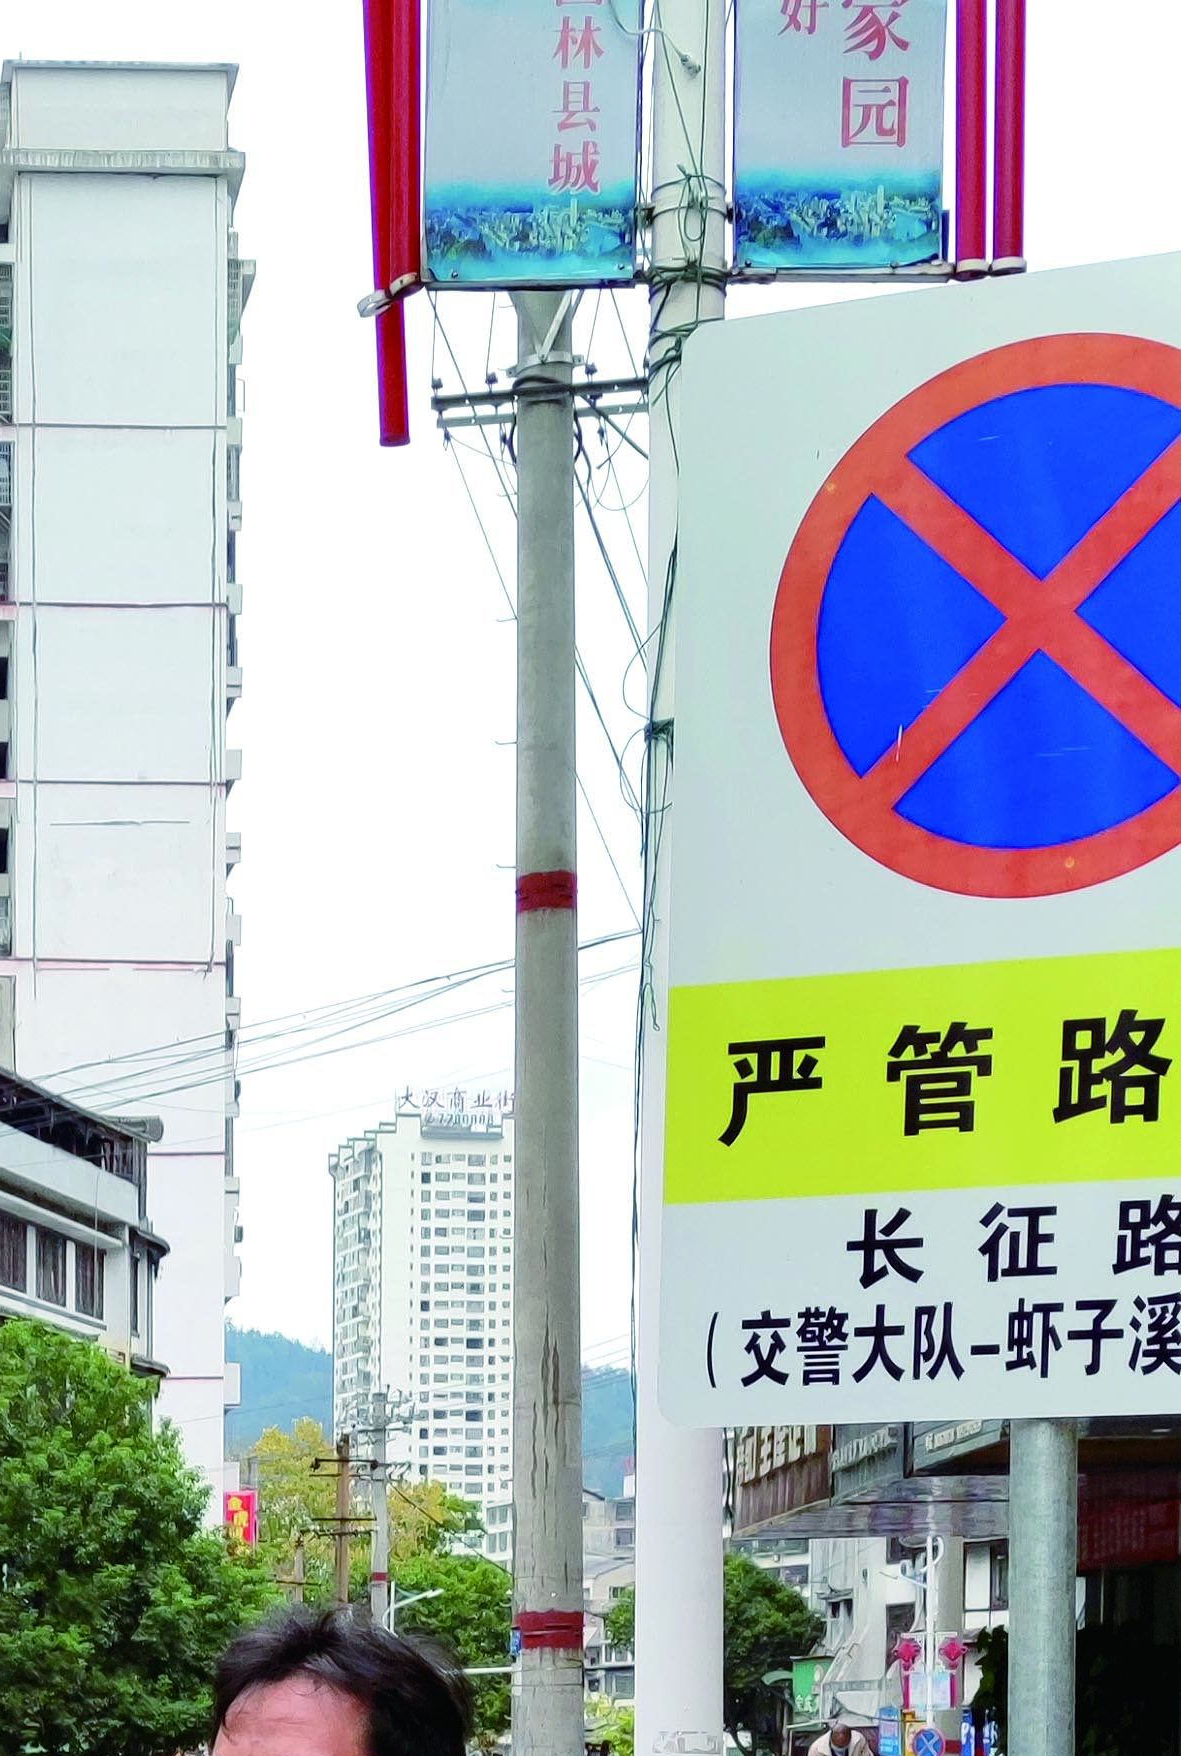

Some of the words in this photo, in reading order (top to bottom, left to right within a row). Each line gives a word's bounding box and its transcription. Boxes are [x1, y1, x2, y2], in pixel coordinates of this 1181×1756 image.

[548, 0, 605, 192] 林县城
[841, 0, 909, 148] 家园
[718, 1009, 1172, 1147] 严管路
[846, 1194, 1181, 1289] 长征路
